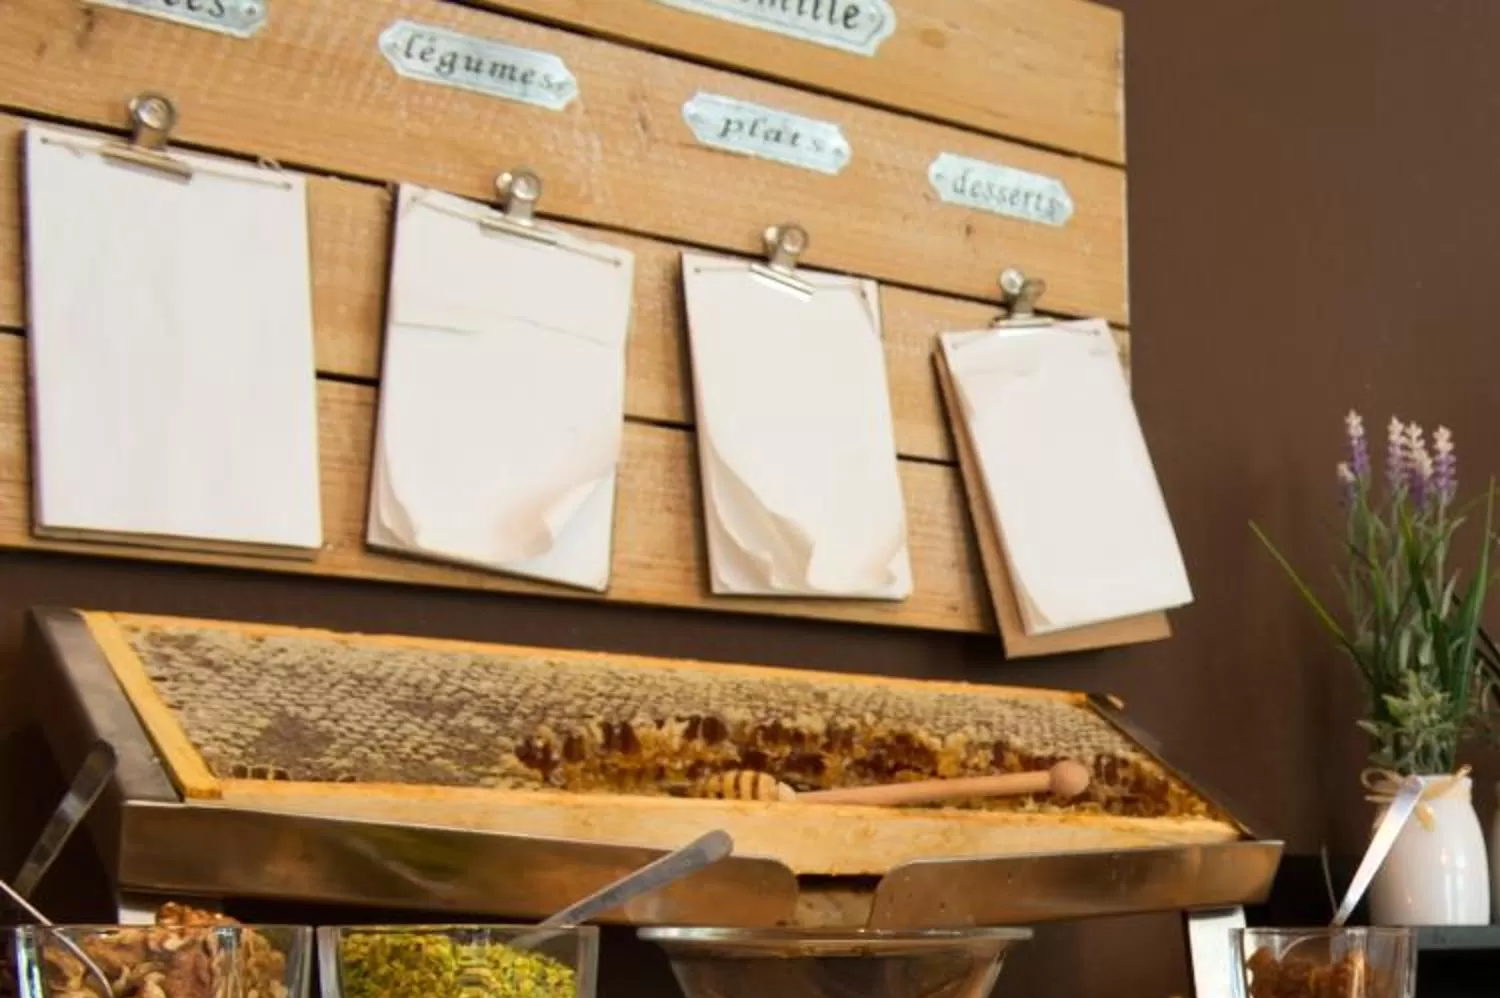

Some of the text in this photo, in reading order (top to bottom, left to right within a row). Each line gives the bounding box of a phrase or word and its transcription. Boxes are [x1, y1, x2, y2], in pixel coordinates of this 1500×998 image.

[404, 32, 555, 90] légumes
[719, 116, 826, 153] plats
[951, 166, 1058, 220] desserts
